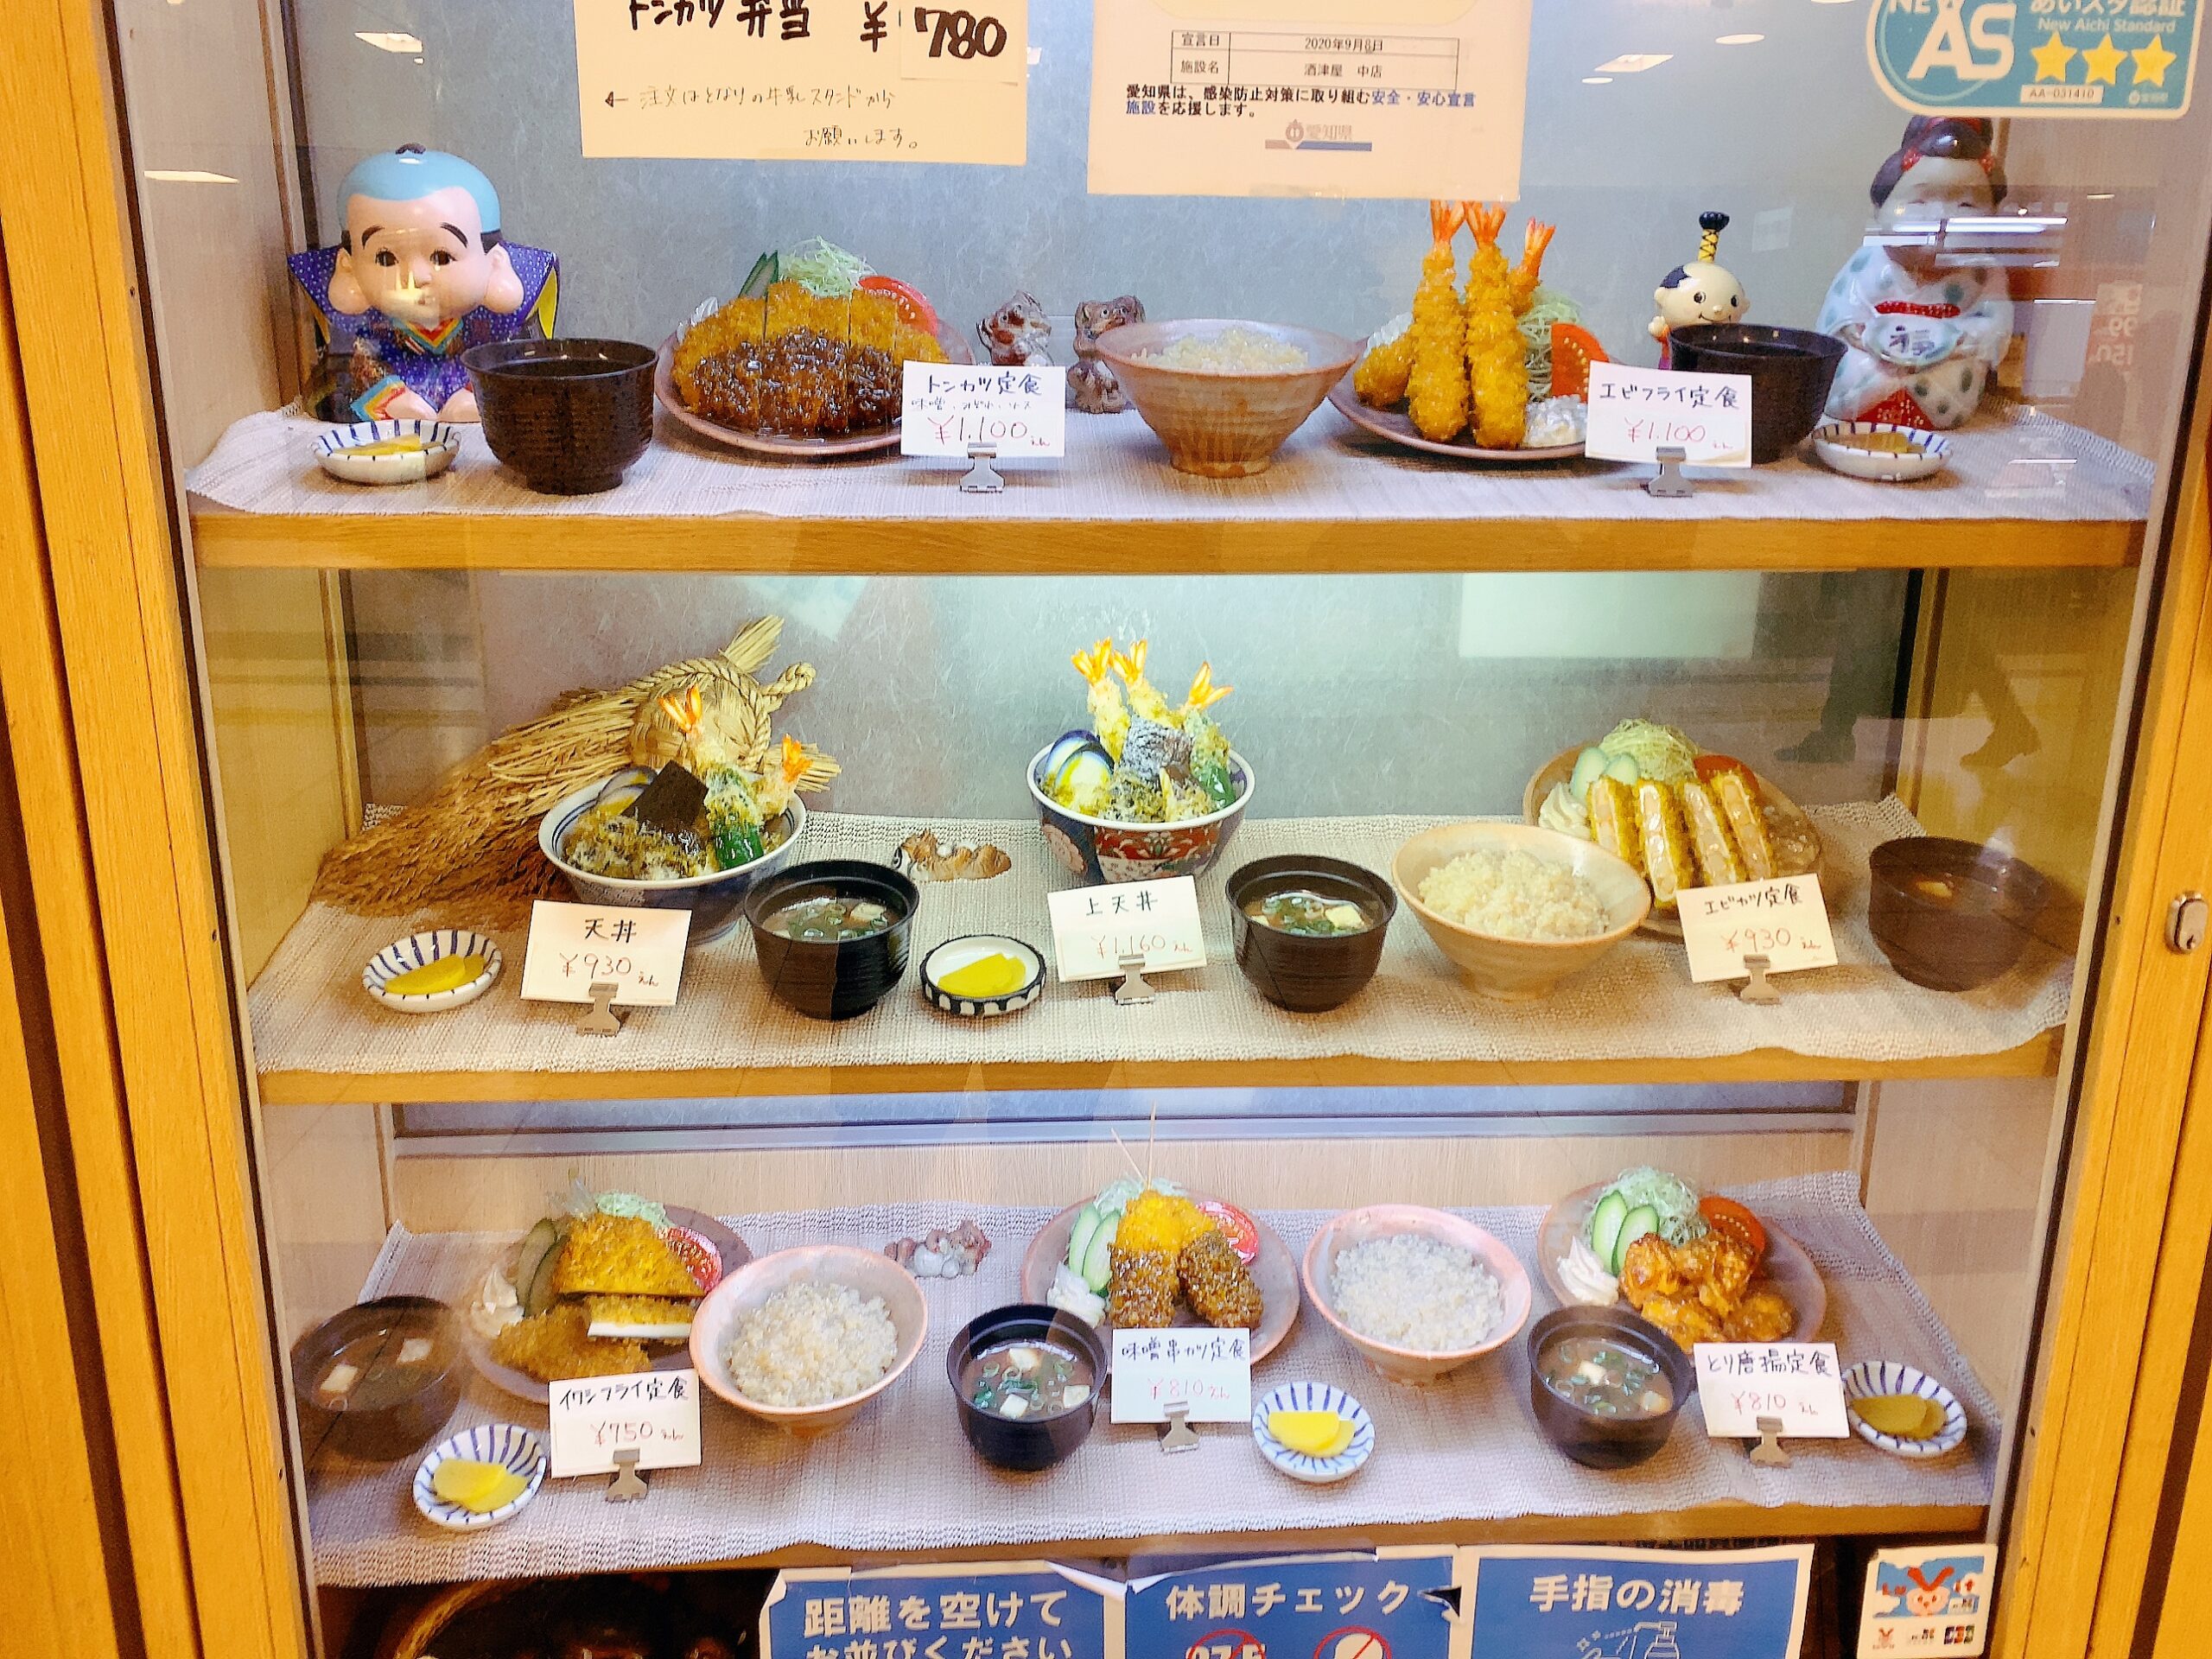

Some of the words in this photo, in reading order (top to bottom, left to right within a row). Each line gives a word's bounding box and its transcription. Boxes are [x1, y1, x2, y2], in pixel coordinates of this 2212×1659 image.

[2037, 17, 2071, 31] New
[2075, 18, 2110, 32] Aichi
[2113, 19, 2177, 33] Standard
[1181, 33, 1220, 48] 宣言日
[1180, 60, 1220, 74] 施設名
[928, 370, 1042, 395] トンカツ定食
[1599, 383, 1740, 410] エビフライ定食
[1704, 882, 1804, 916] エビカツ定食
[583, 918, 637, 944] 天丼
[1122, 1335, 1247, 1364] 味噌串カツ定食
[1707, 1348, 1833, 1377] とり唐揚定食
[559, 1375, 690, 1410] イワシフライ定食
[1165, 1580, 1411, 1621] 体調チェック
[1529, 1573, 1746, 1617] 手指の消毒
[803, 1590, 1069, 1639] 距離を空けて
